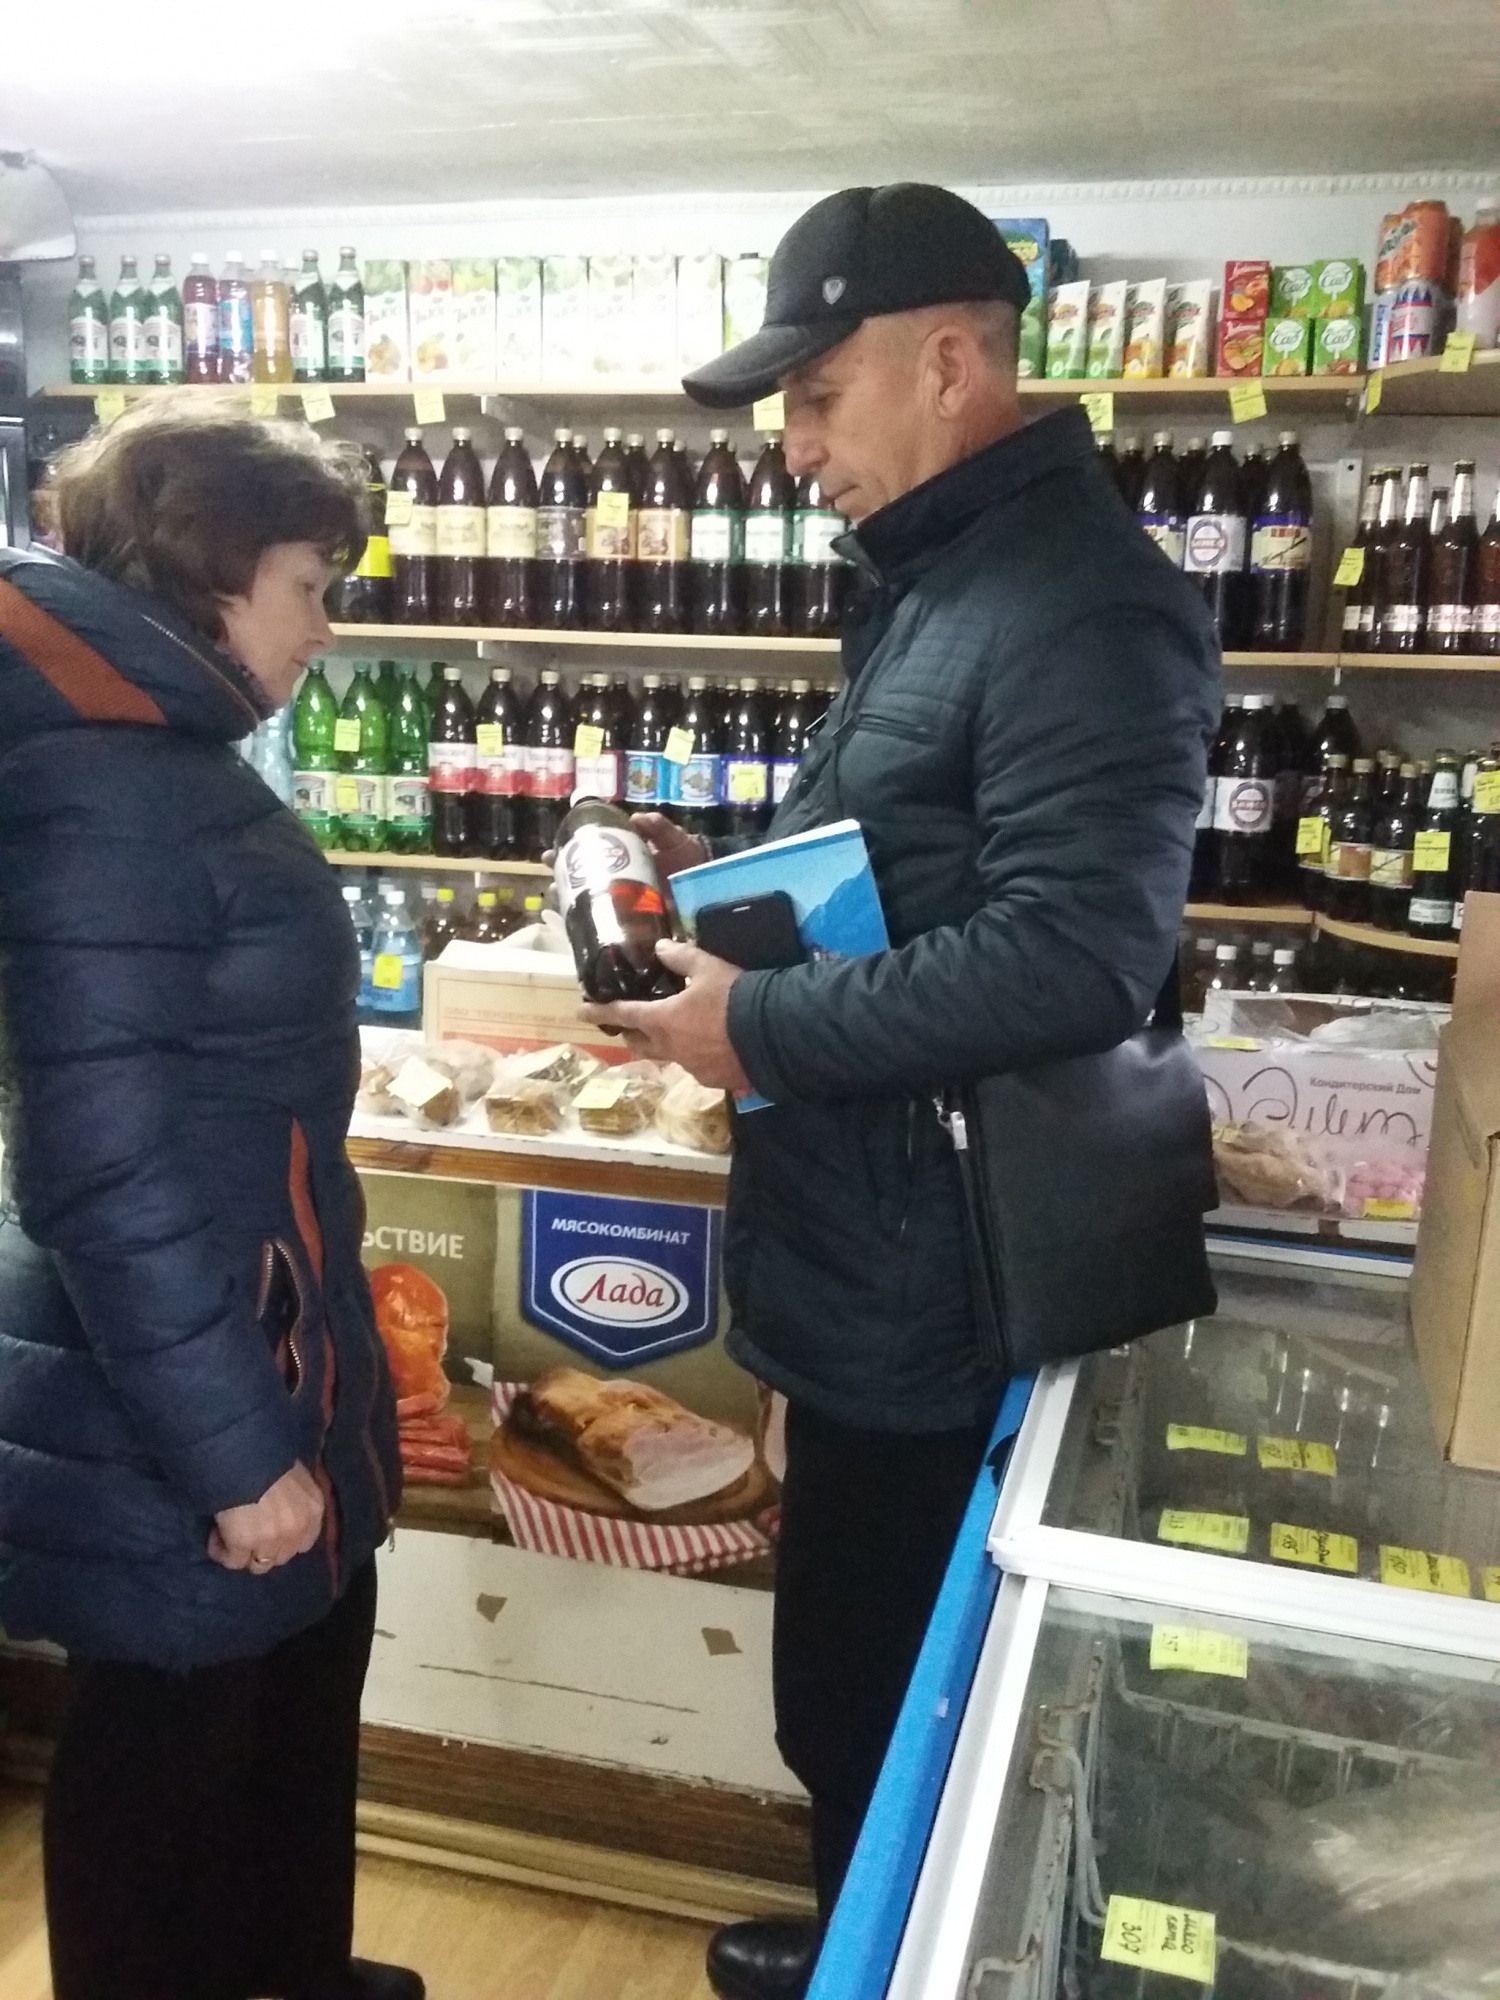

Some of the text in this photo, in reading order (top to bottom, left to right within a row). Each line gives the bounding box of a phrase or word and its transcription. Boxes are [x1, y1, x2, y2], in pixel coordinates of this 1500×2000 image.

[1309, 1076, 1422, 1095] Кондитерский Дом
[551, 1217, 691, 1246] МЯСОКОМБИНАТ
[576, 1272, 666, 1309] Лада
